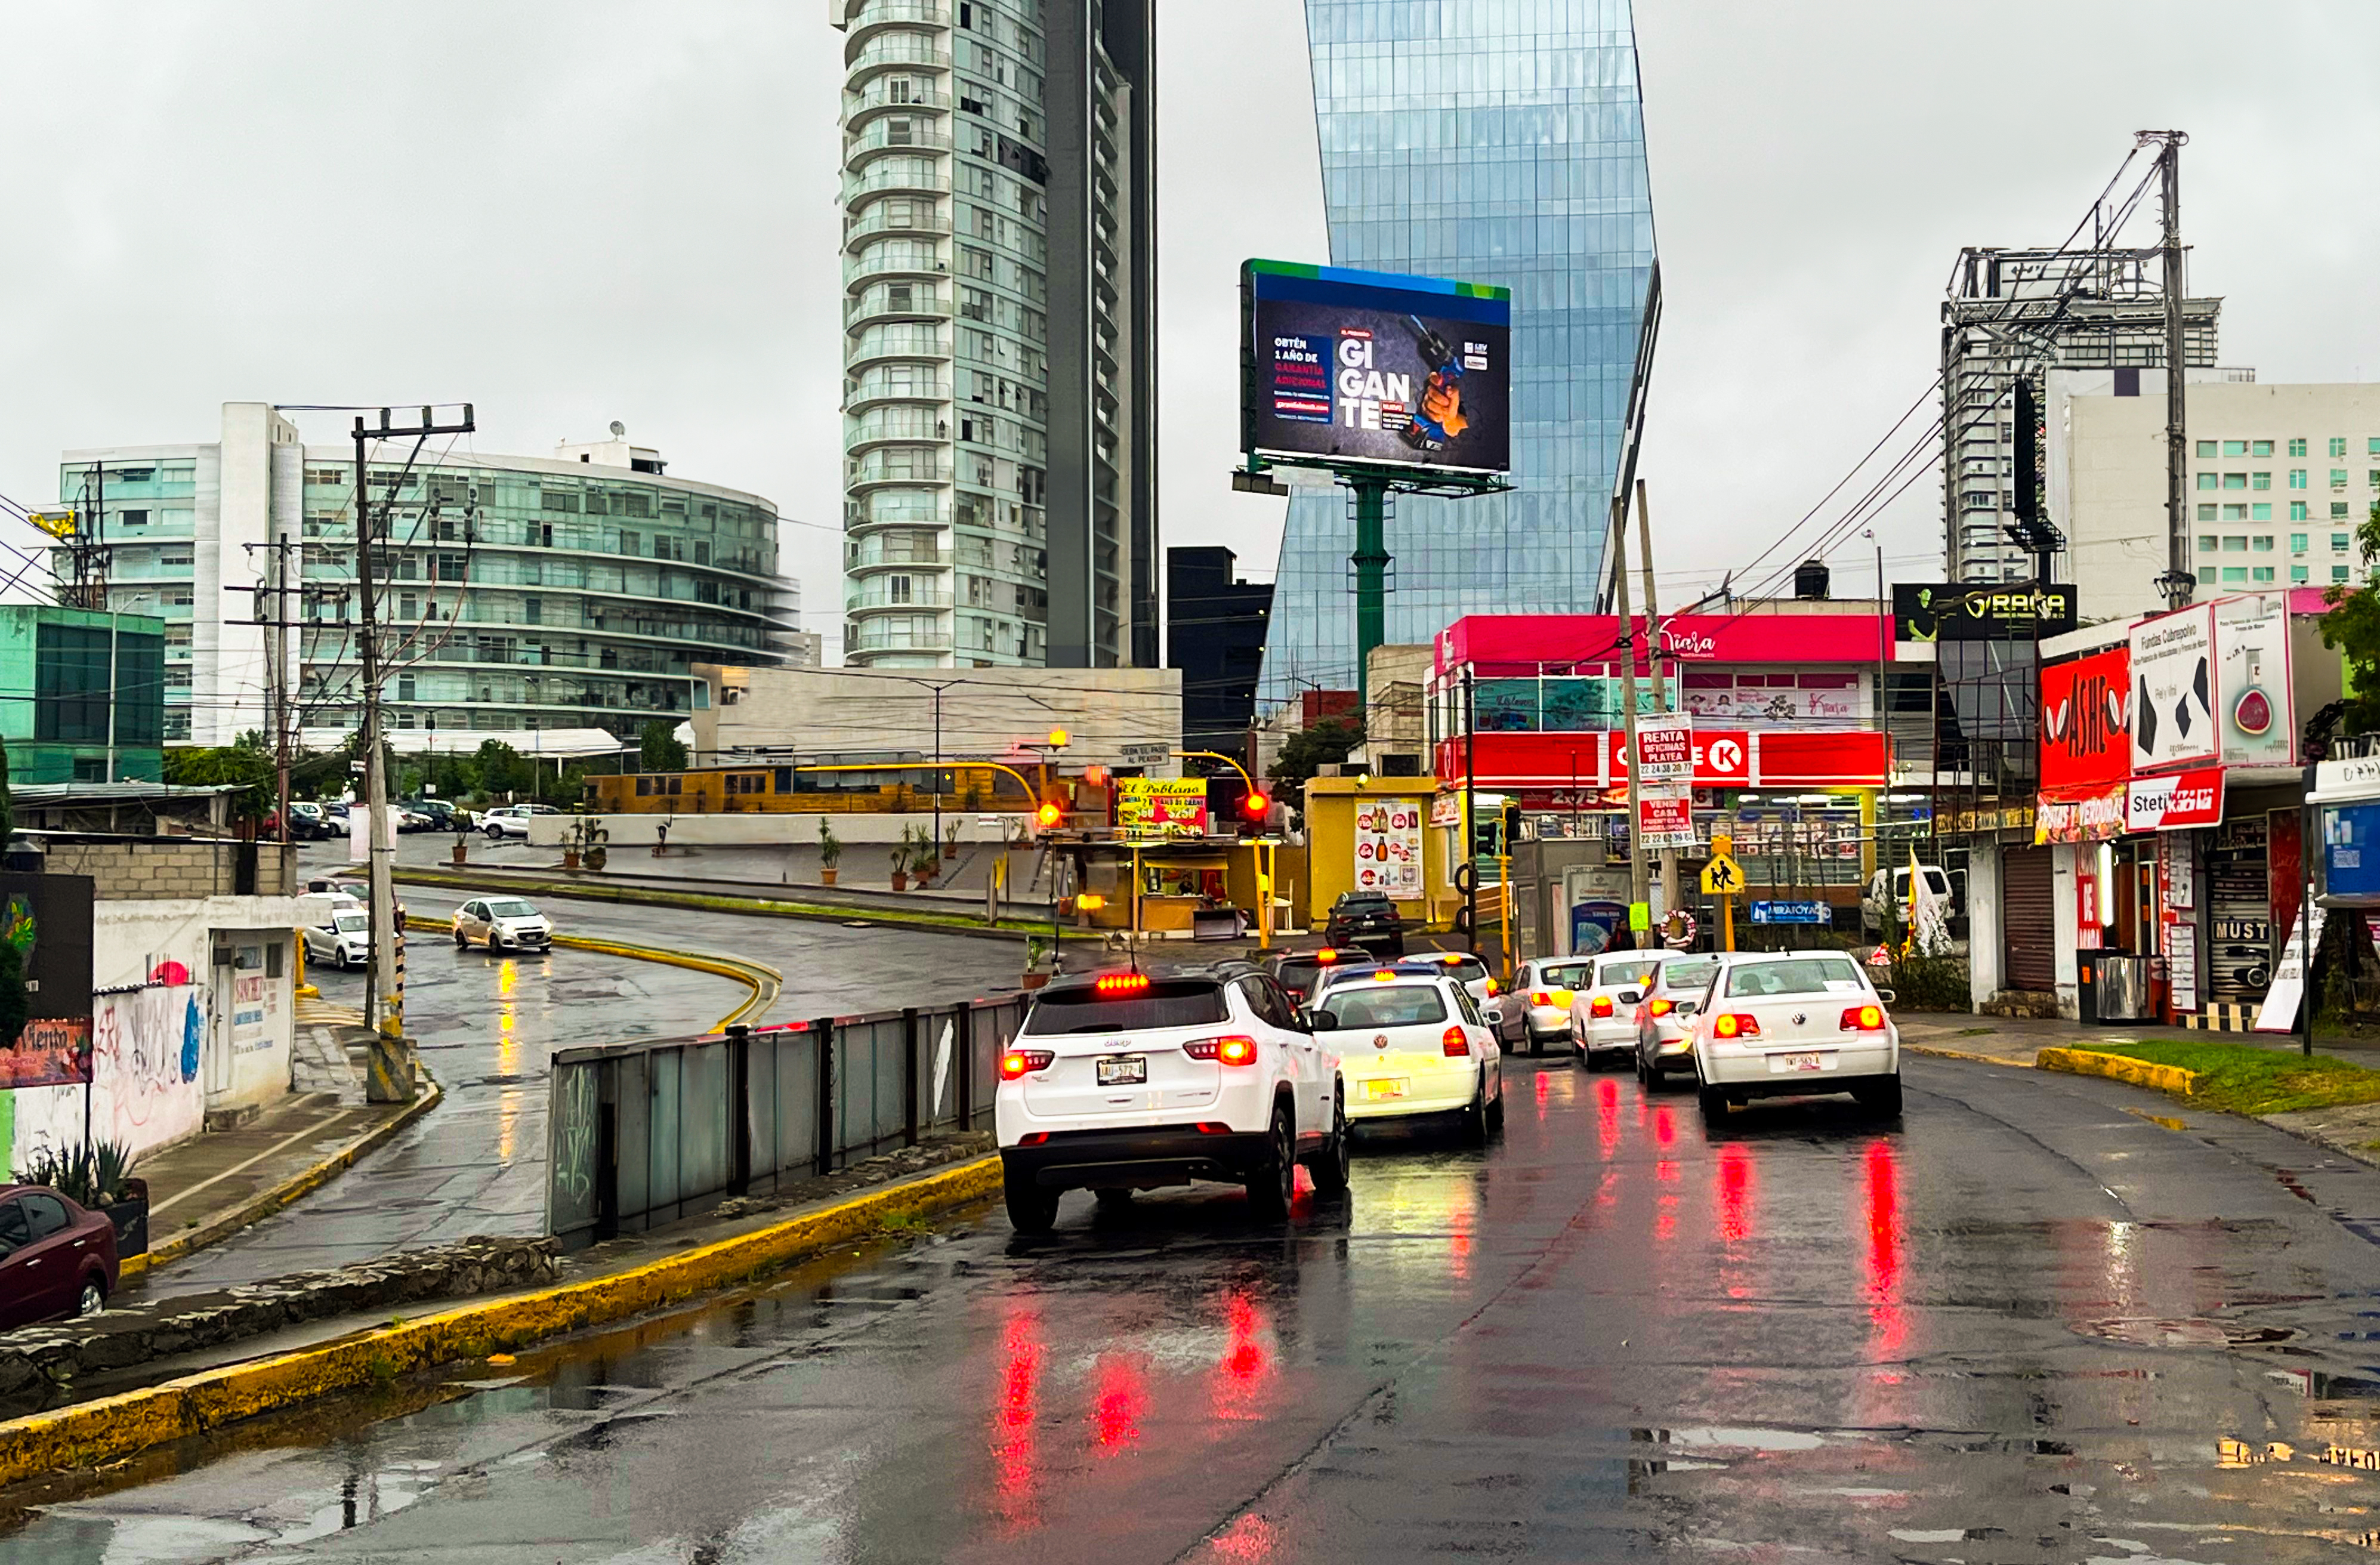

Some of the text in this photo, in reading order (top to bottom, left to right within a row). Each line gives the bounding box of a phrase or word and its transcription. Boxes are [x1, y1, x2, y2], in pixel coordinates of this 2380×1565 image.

[1274, 337, 1307, 350] OBTÉN
[1275, 349, 1317, 363] 1 AÑO DE
[1339, 339, 1372, 369] GI
[1339, 369, 1409, 403] GAN
[1339, 397, 1379, 430] TE
[1643, 731, 1686, 743] RENTA
[1644, 743, 1686, 753] OFICINAS
[1648, 752, 1683, 762] PLATEA
[1141, 782, 1199, 794] Poblano
[1649, 800, 1680, 808] VENDE
[1653, 809, 1678, 817] CASA
[2216, 922, 2267, 939] MUST
